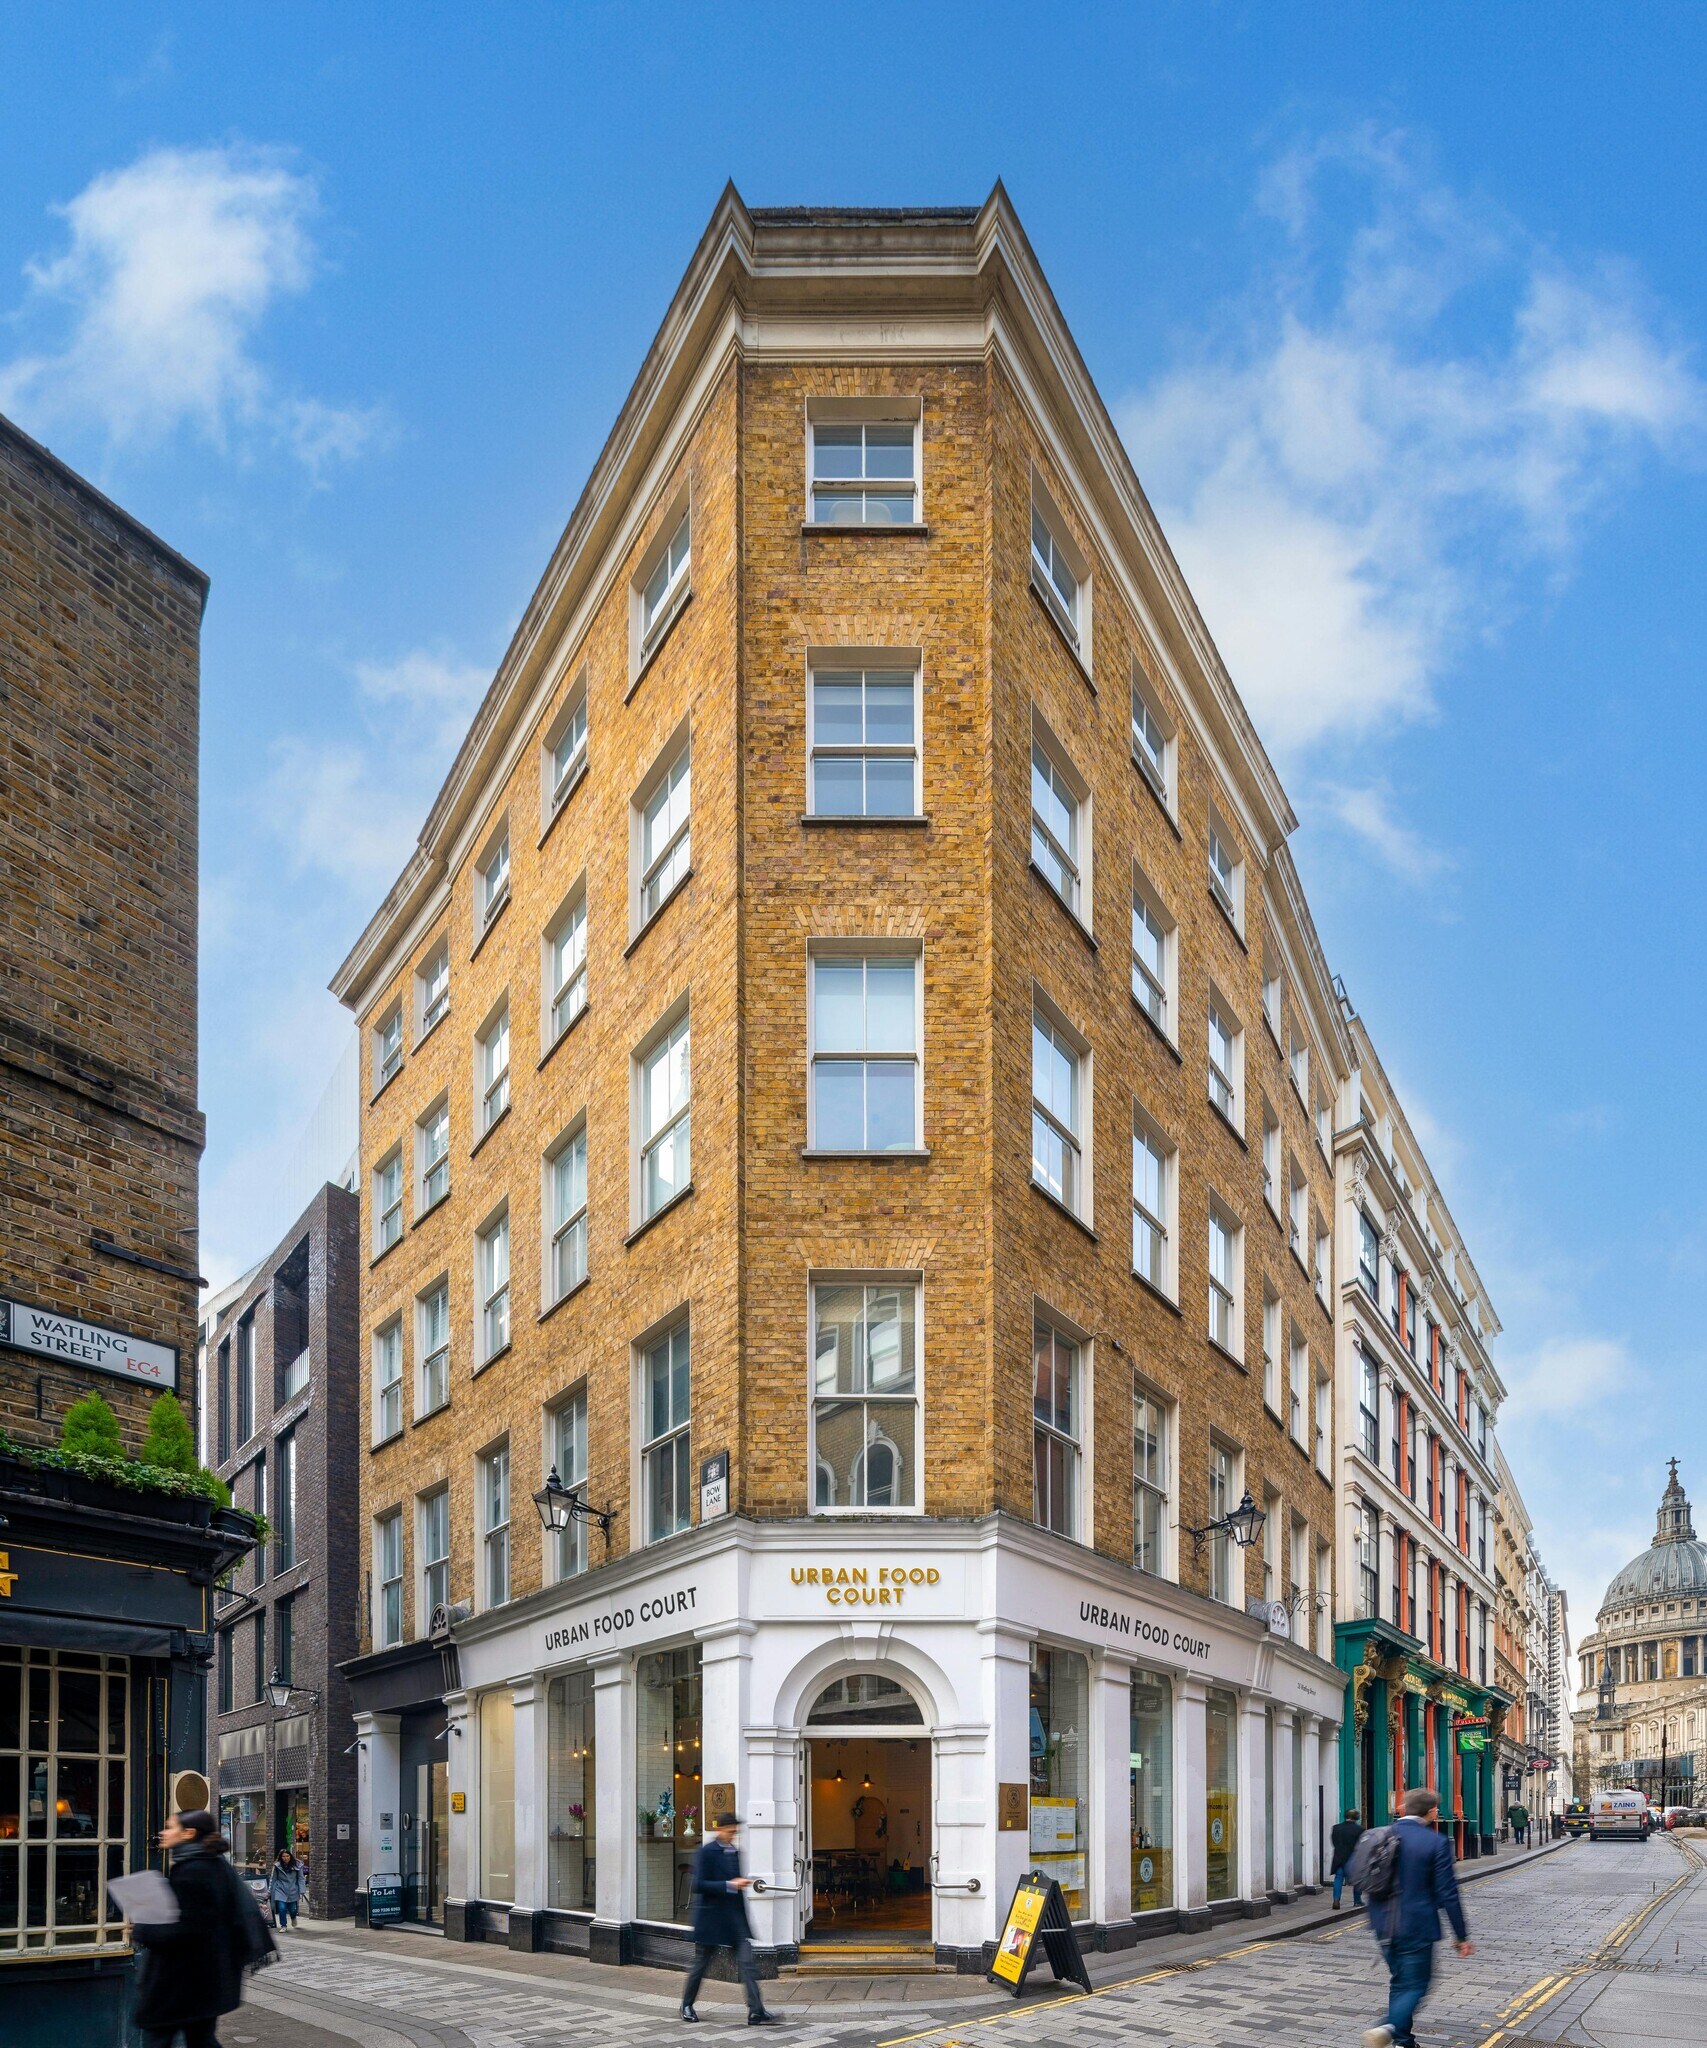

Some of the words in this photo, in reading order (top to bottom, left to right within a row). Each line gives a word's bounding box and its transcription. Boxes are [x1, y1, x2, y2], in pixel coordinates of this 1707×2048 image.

[31, 1314, 128, 1353] WATLING
[31, 1331, 106, 1362] STREET
[126, 1357, 161, 1377] EC4
[706, 1484, 720, 1497] BOW
[706, 1494, 721, 1507] LANE
[790, 1567, 867, 1585] URBAN
[879, 1567, 940, 1585] FOOD
[826, 1587, 905, 1605] COURT
[545, 1622, 590, 1651] URBAN
[593, 1608, 635, 1637] FOOD
[640, 1586, 697, 1622] COURT
[1080, 1601, 1130, 1634] URBAN
[1134, 1619, 1170, 1646] FOOD
[1173, 1633, 1211, 1659] COURT
